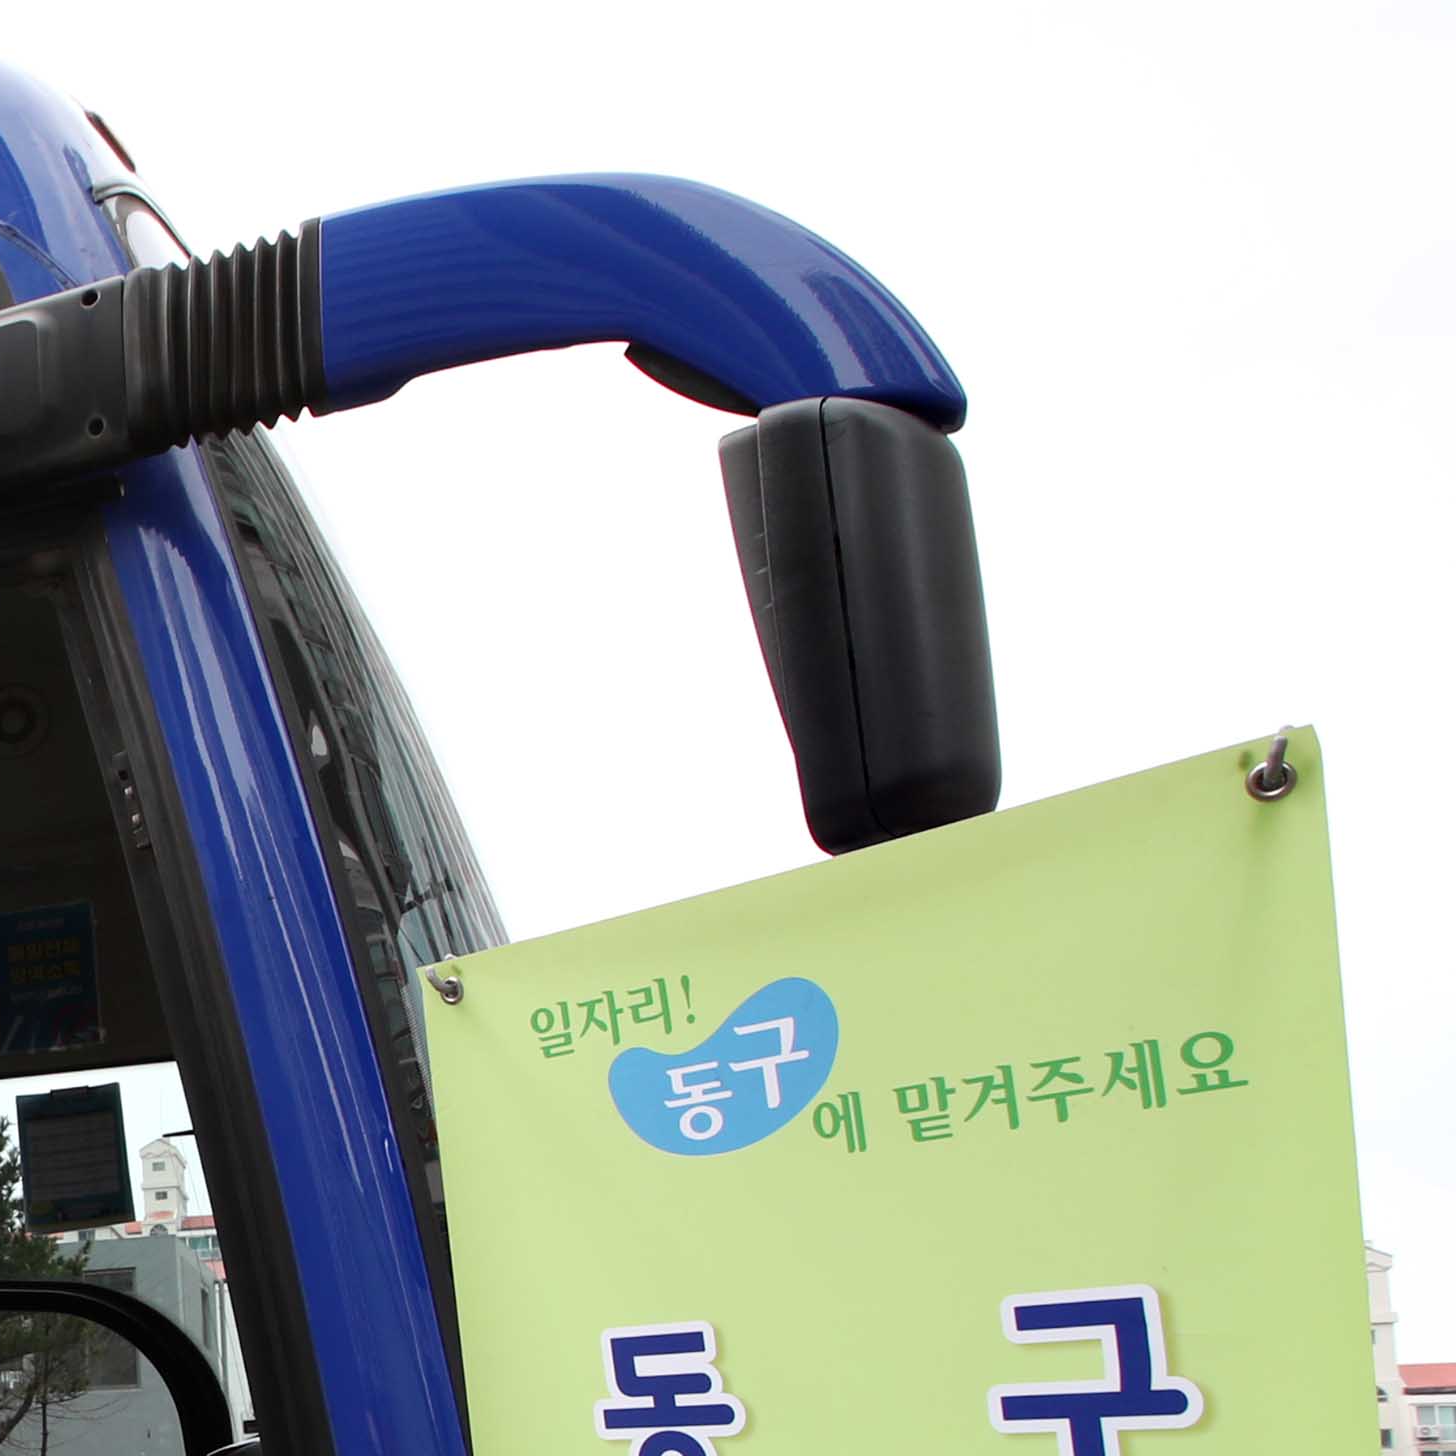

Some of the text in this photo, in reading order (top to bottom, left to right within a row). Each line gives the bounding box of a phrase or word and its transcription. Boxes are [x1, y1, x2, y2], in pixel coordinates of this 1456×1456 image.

[530, 974, 698, 1058] 일자리!
[664, 1016, 810, 1140] 동구
[893, 1030, 1249, 1144] 맡겨주세요
